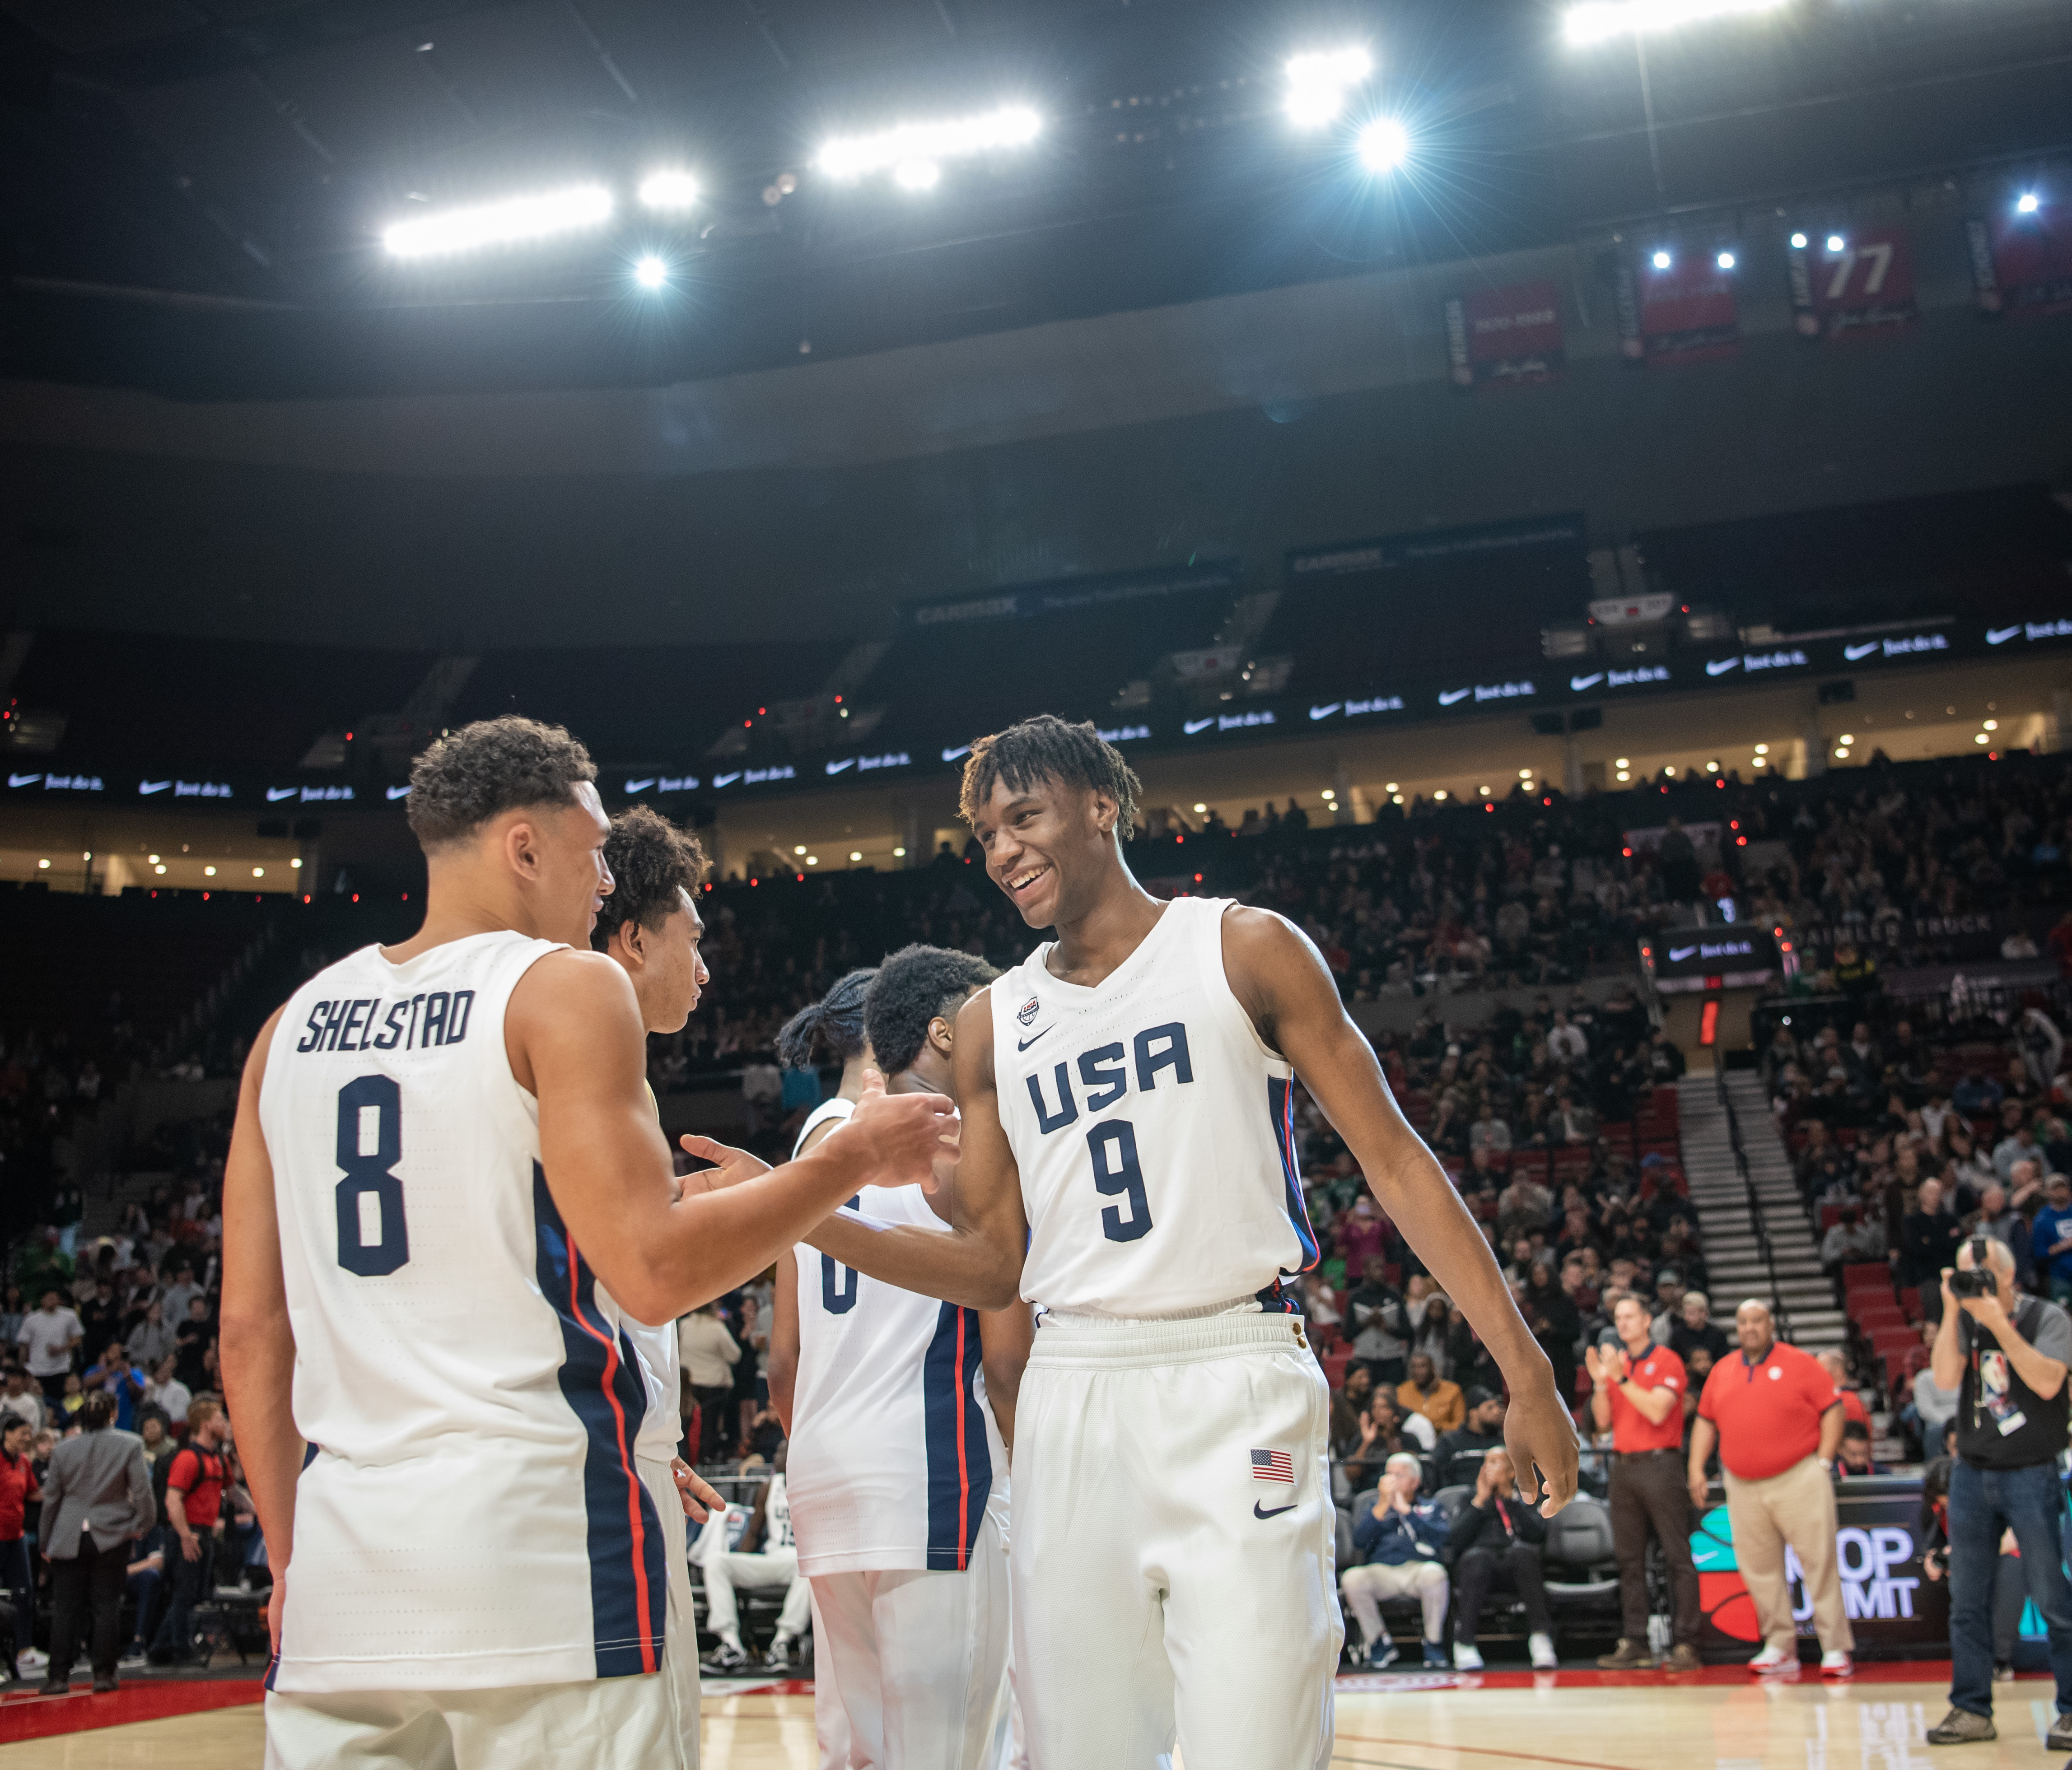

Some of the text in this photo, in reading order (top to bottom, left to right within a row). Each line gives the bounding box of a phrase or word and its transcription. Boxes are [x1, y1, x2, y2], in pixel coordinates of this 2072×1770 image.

[297, 990, 476, 1053] SHELSTAD
[1026, 1021, 1194, 1135] USA
[336, 1073, 410, 1277] 8
[1086, 1119, 1153, 1243] 9
